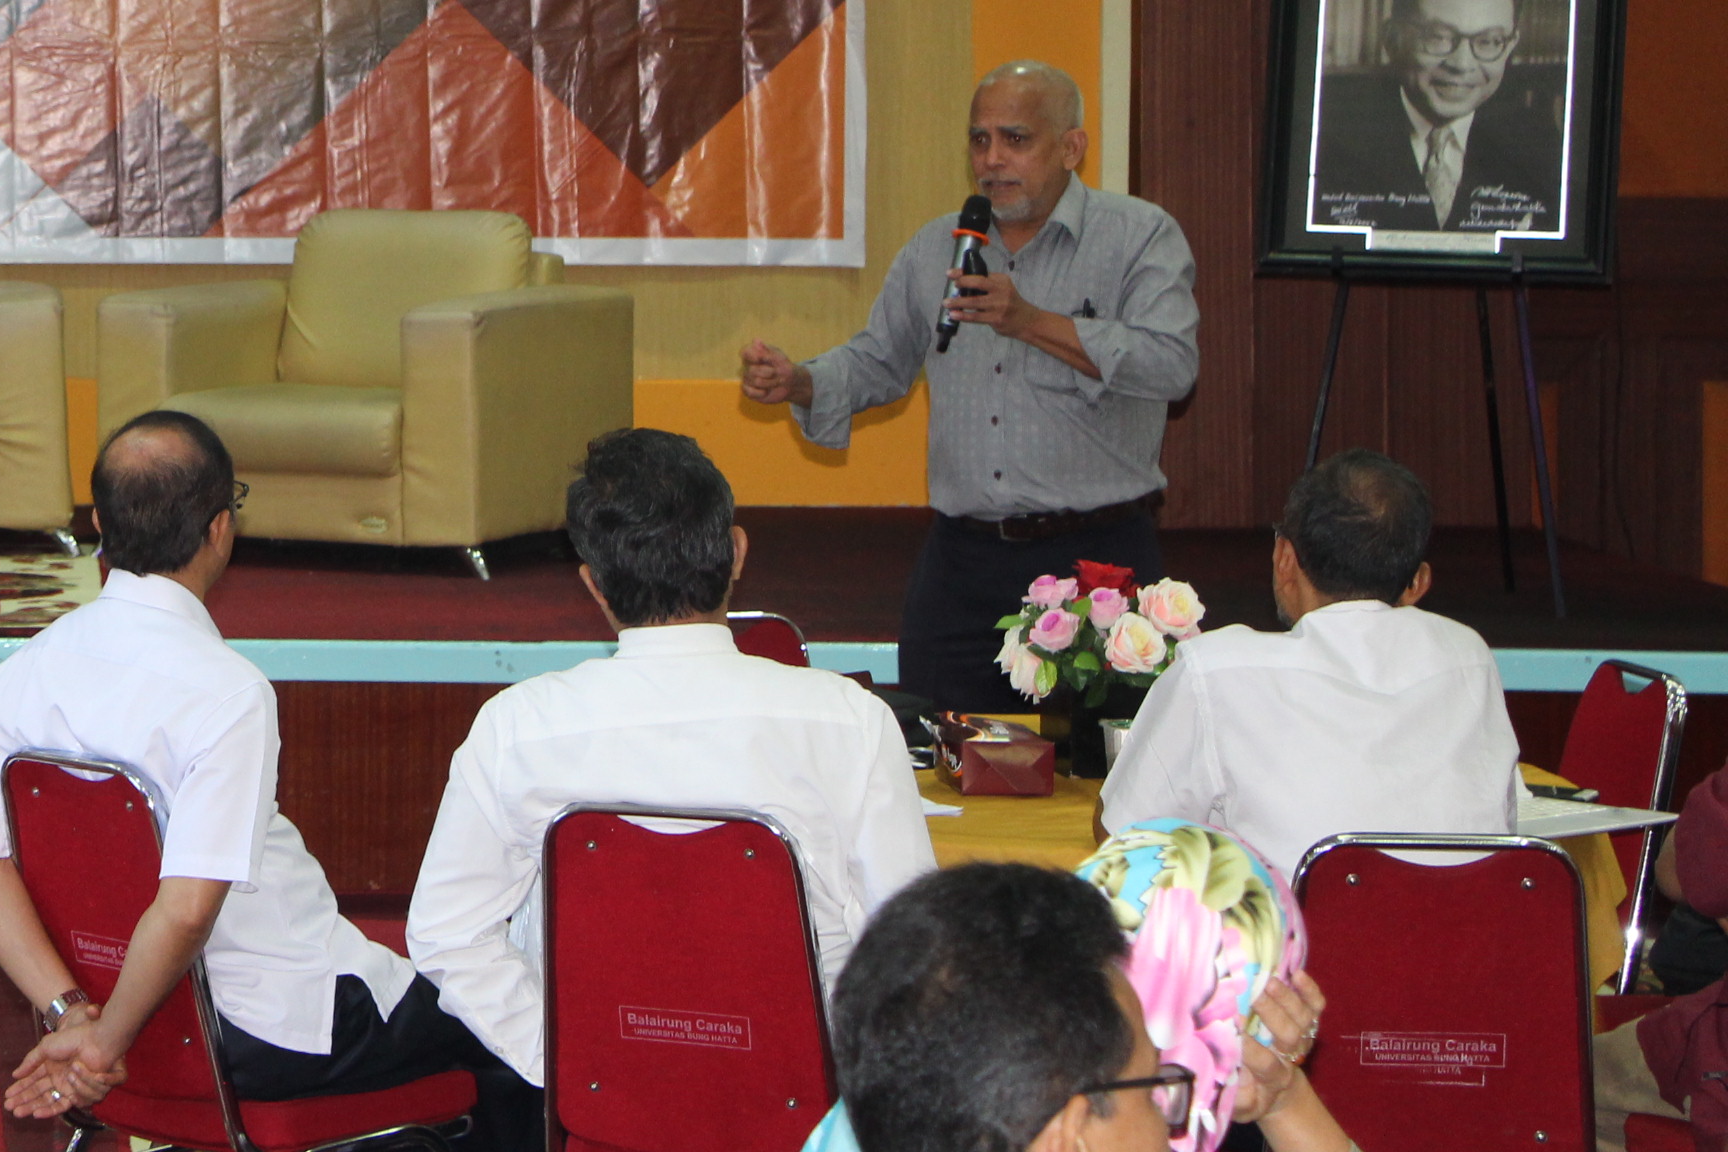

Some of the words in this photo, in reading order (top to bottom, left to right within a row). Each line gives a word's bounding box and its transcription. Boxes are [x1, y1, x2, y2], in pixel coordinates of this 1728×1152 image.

[627, 1011, 693, 1033] Balairung
[696, 1018, 743, 1035] Caraka
[1369, 1038, 1441, 1054] Balairung
[1445, 1039, 1497, 1053] Caraka
